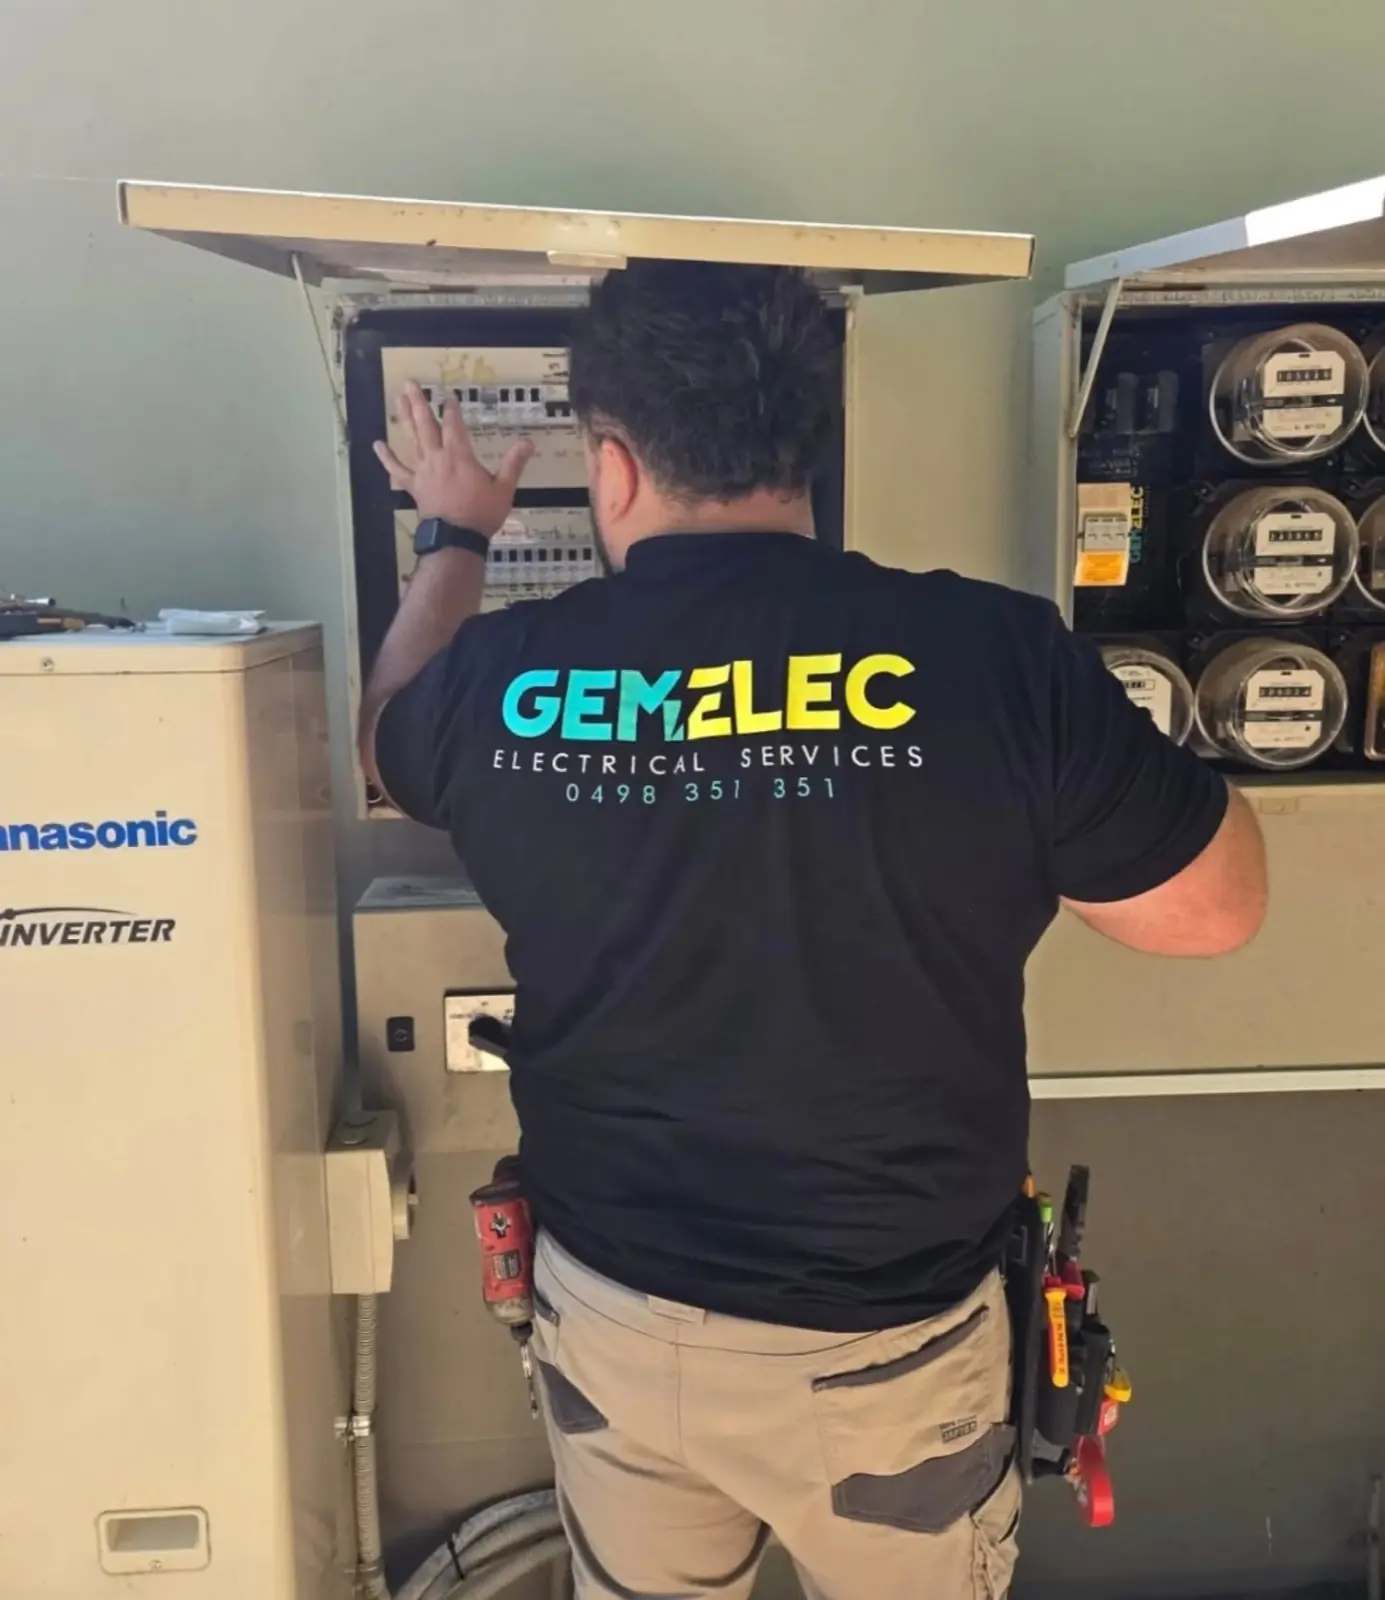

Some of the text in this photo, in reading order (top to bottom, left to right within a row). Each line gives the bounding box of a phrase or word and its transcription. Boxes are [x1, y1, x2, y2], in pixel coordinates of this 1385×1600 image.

[501, 653, 917, 742] GEMELEC
[492, 744, 924, 775] ELECTRICAL SERVICES
[565, 776, 835, 805] 0498 351 351
[0, 810, 198, 851] nasonic
[0, 918, 176, 947] INVERTER
